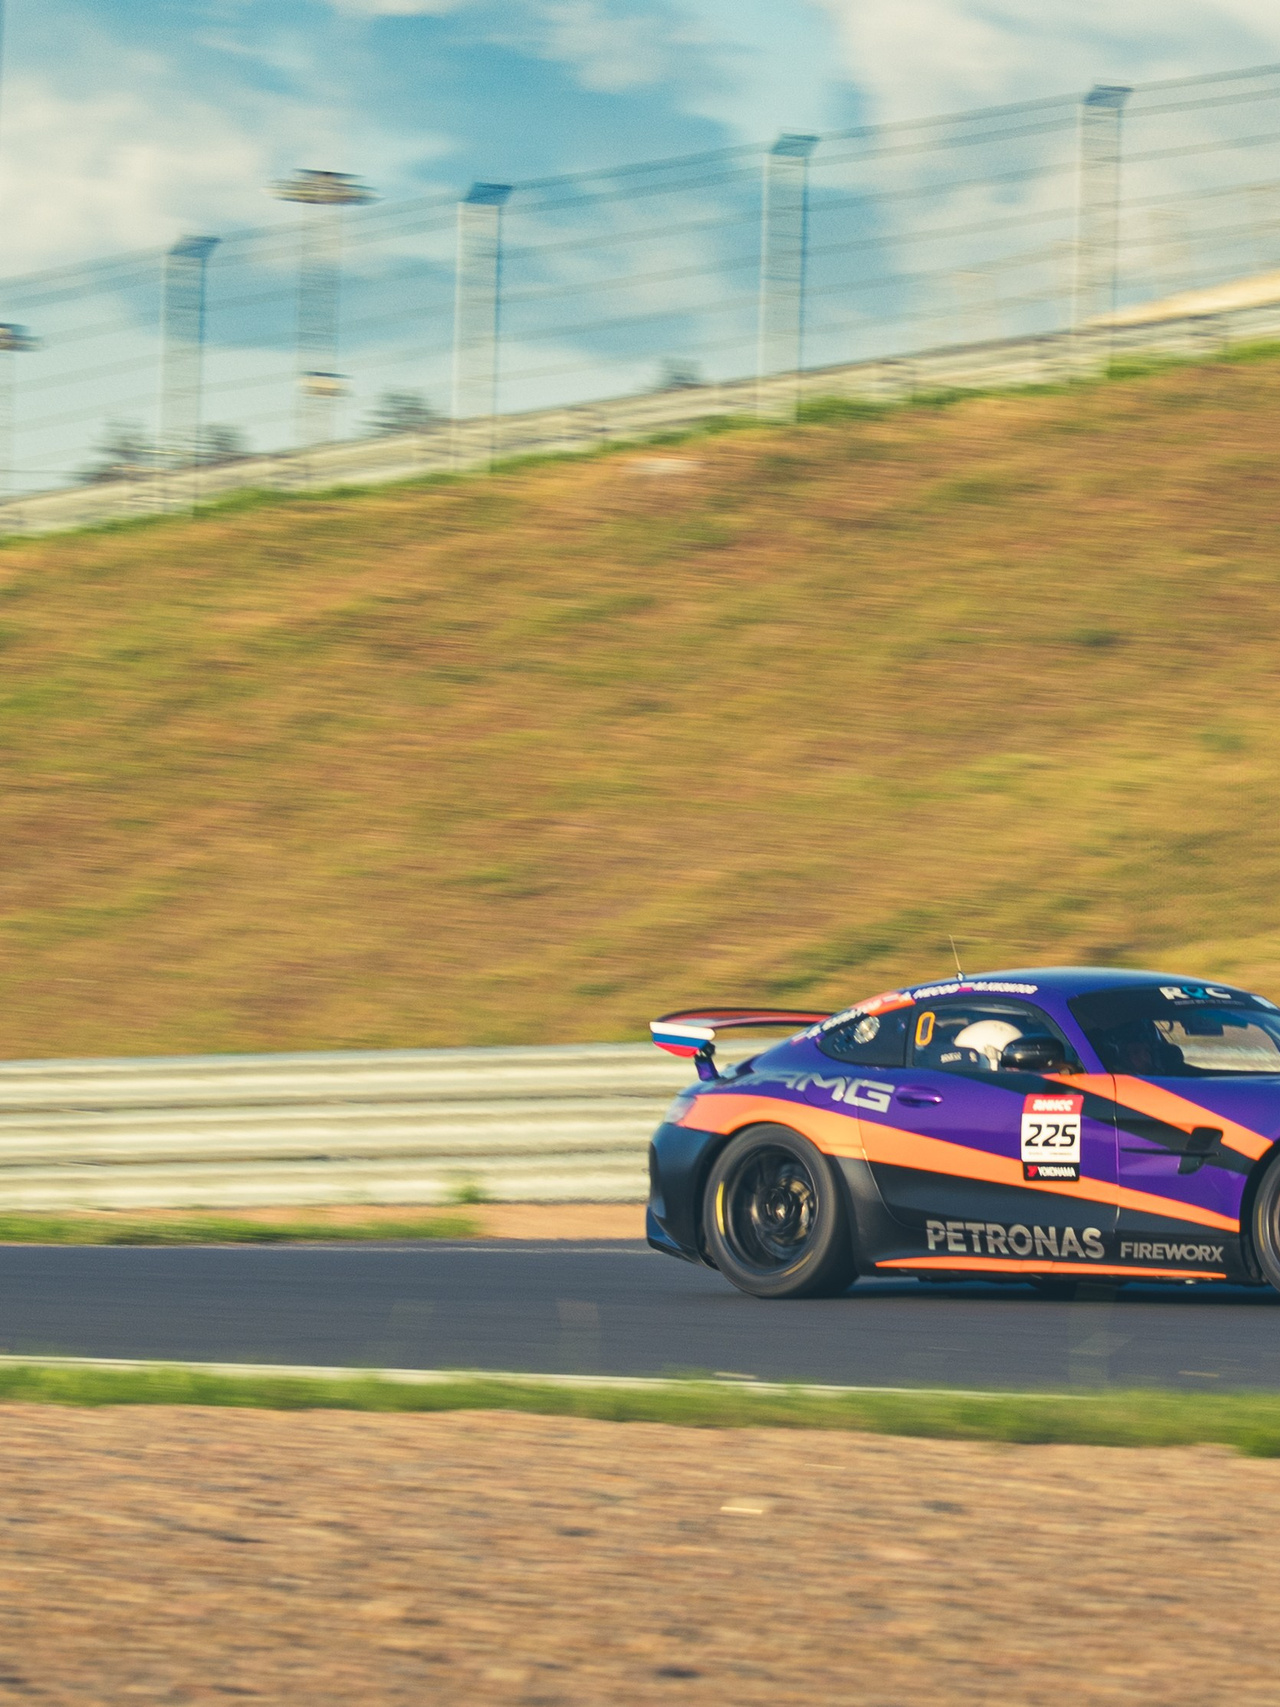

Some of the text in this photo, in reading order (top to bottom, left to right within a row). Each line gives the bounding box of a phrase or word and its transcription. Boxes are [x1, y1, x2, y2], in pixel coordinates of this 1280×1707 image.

[764, 1072, 895, 1114] AMG
[1025, 1123, 1077, 1147] 225
[1037, 1166, 1077, 1178] YOKOHAMA
[926, 1220, 1105, 1259] PETRONAS
[1121, 1241, 1224, 1263] FIREWORX
